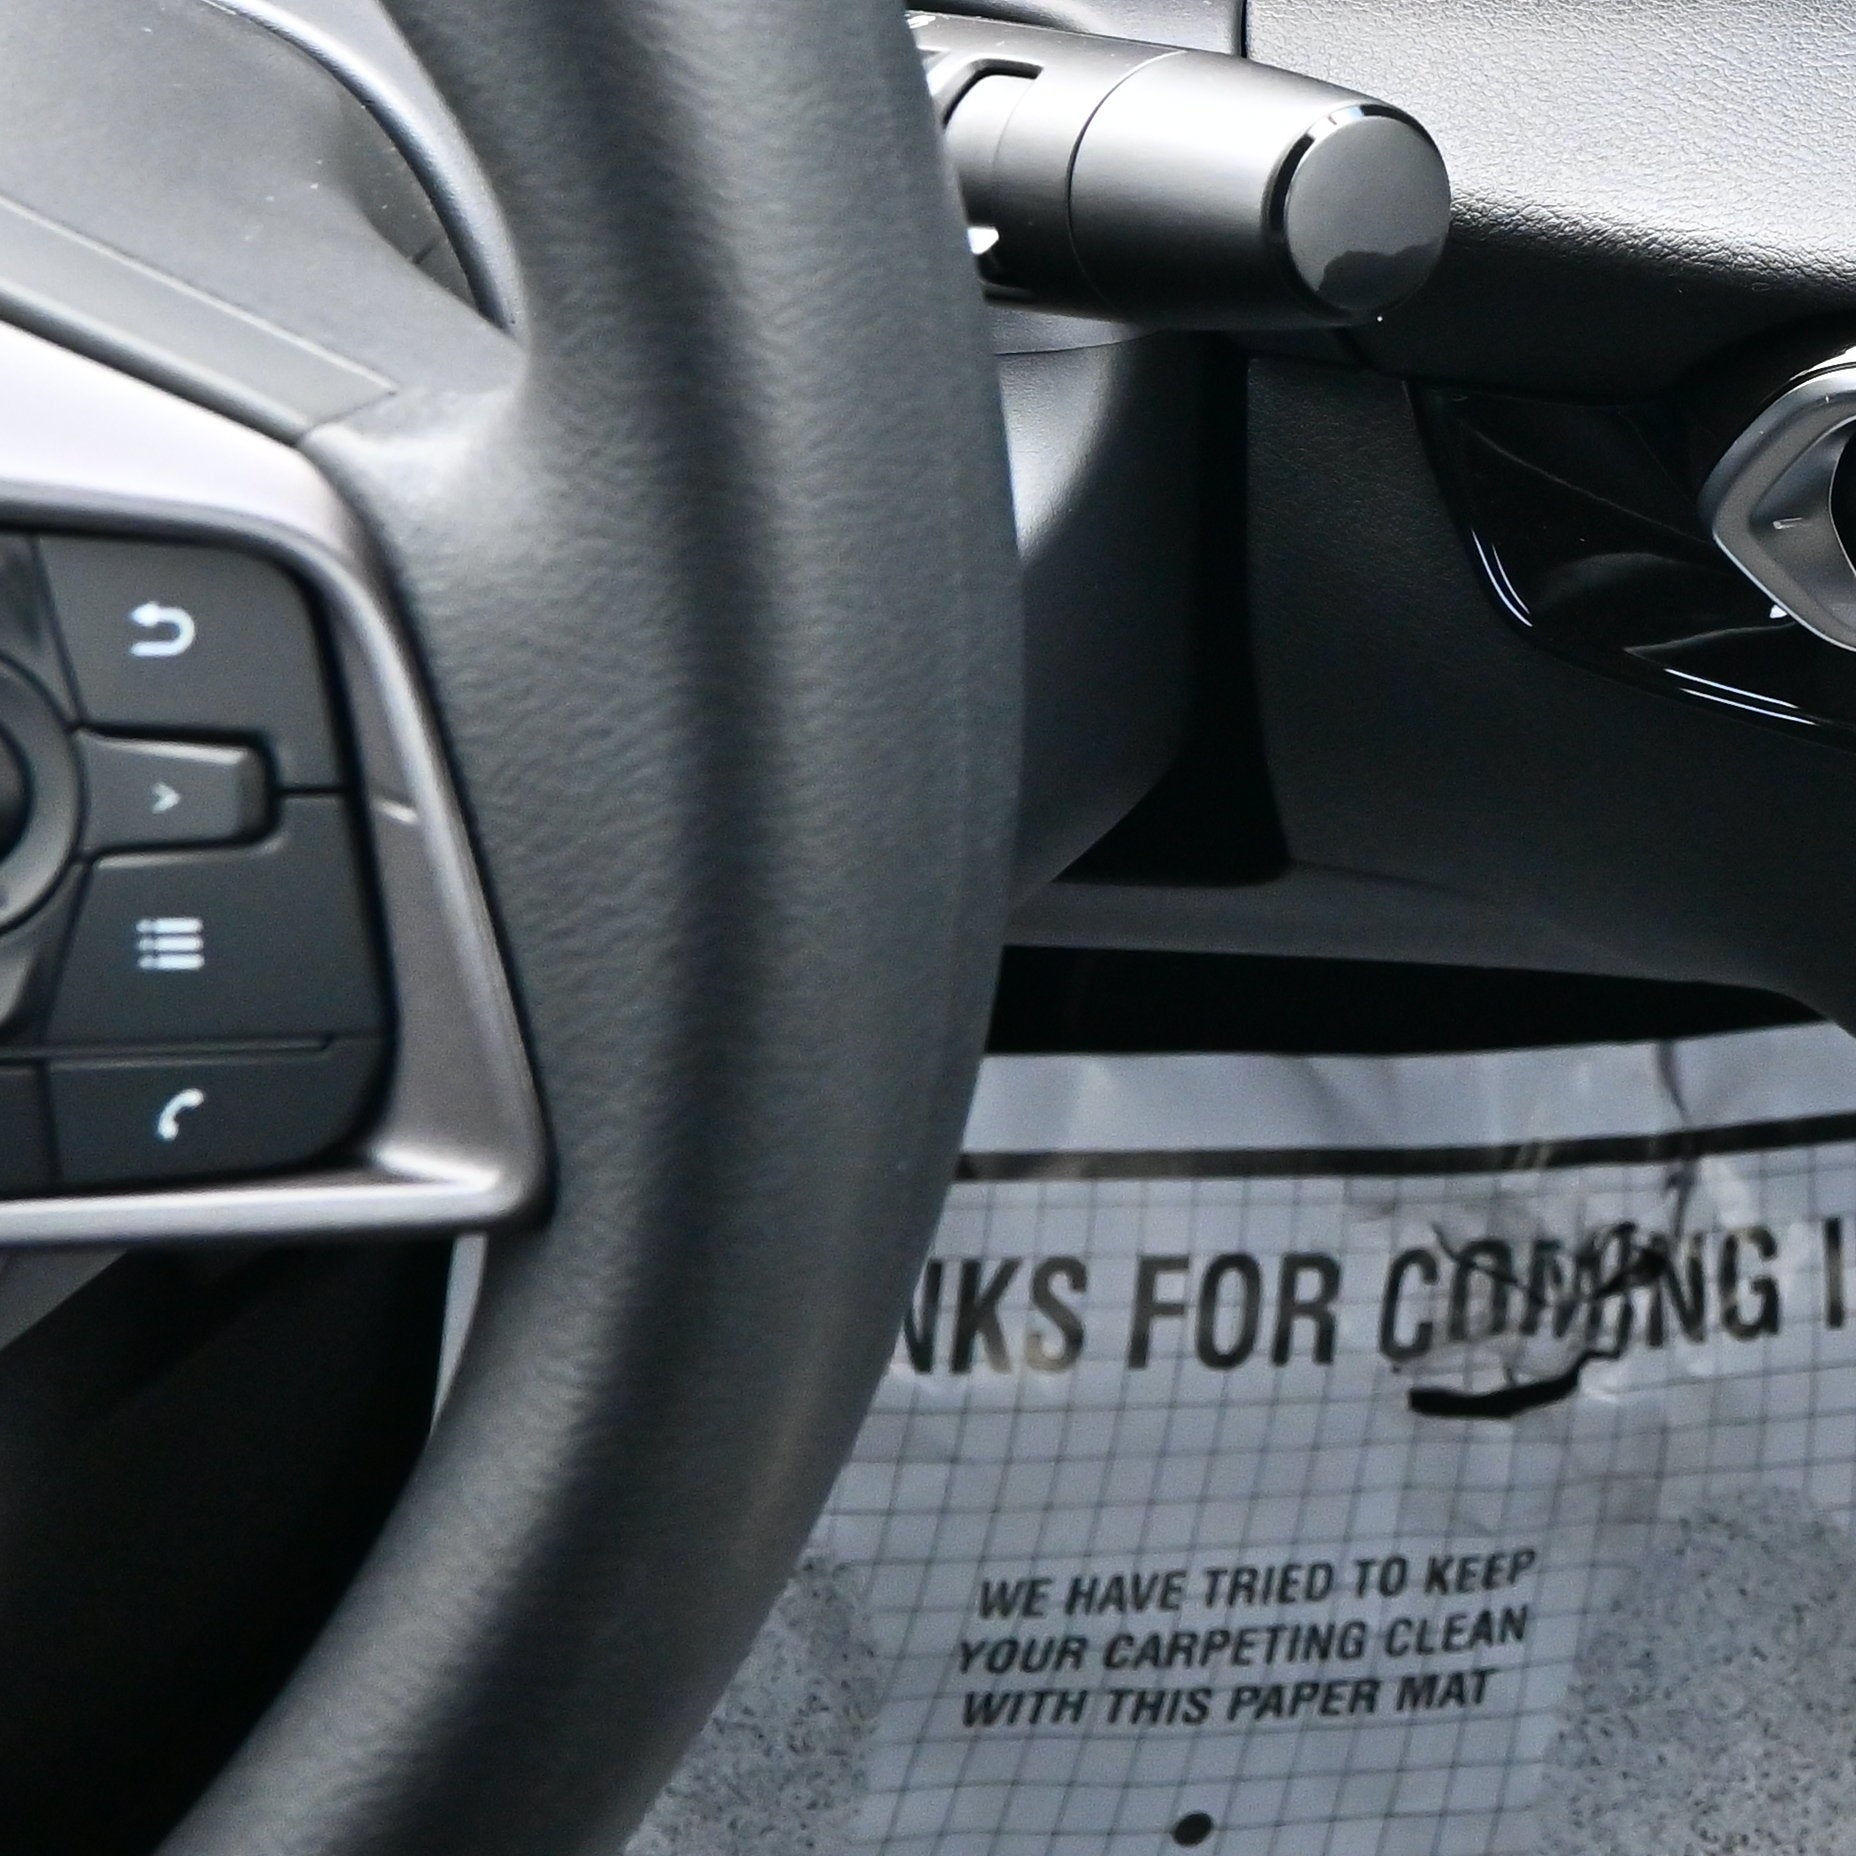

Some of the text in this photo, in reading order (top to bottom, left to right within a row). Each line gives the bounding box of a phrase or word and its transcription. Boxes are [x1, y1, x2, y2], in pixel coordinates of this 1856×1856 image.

[1127, 1251, 1342, 1370] FOR
[978, 1548, 1537, 1620] WE HAVE TRIED TO KEEP
[957, 1605, 1529, 1675] YOUR CARPETING CLEAN
[962, 1668, 1499, 1727] WITH THIS PAPER MAT
